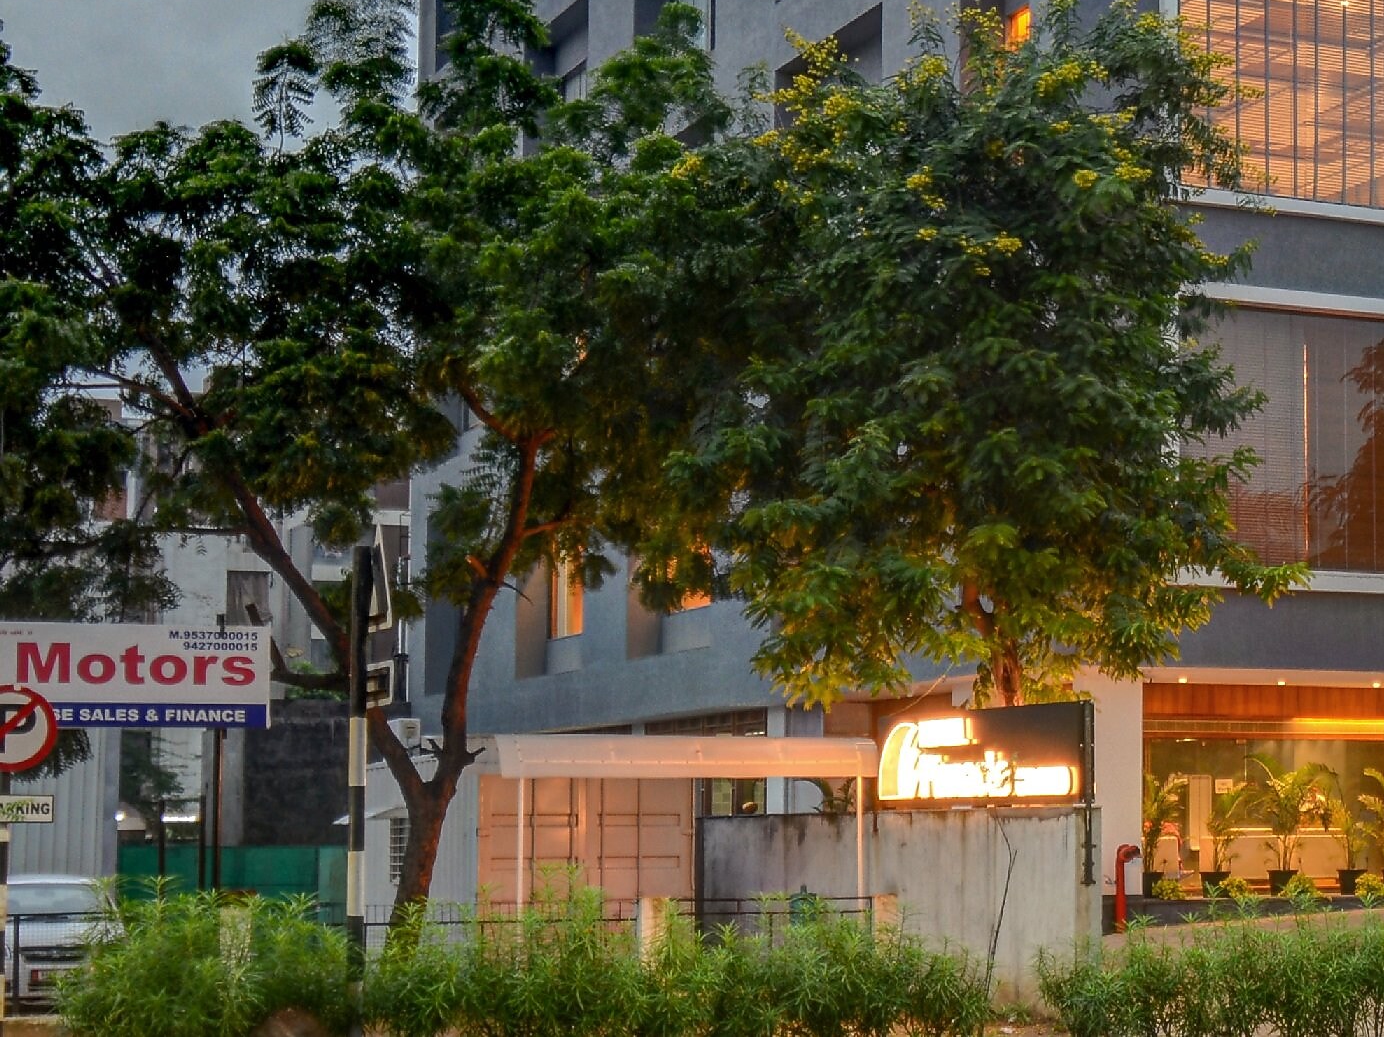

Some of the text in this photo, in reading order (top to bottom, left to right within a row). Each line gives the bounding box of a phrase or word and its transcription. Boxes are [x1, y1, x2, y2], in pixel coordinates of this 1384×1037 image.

[183, 642, 258, 651] 9427000015
[16, 642, 256, 685] Motors
[79, 708, 139, 722] SALES
[145, 708, 159, 722] &
[165, 709, 246, 723] FINANCE
